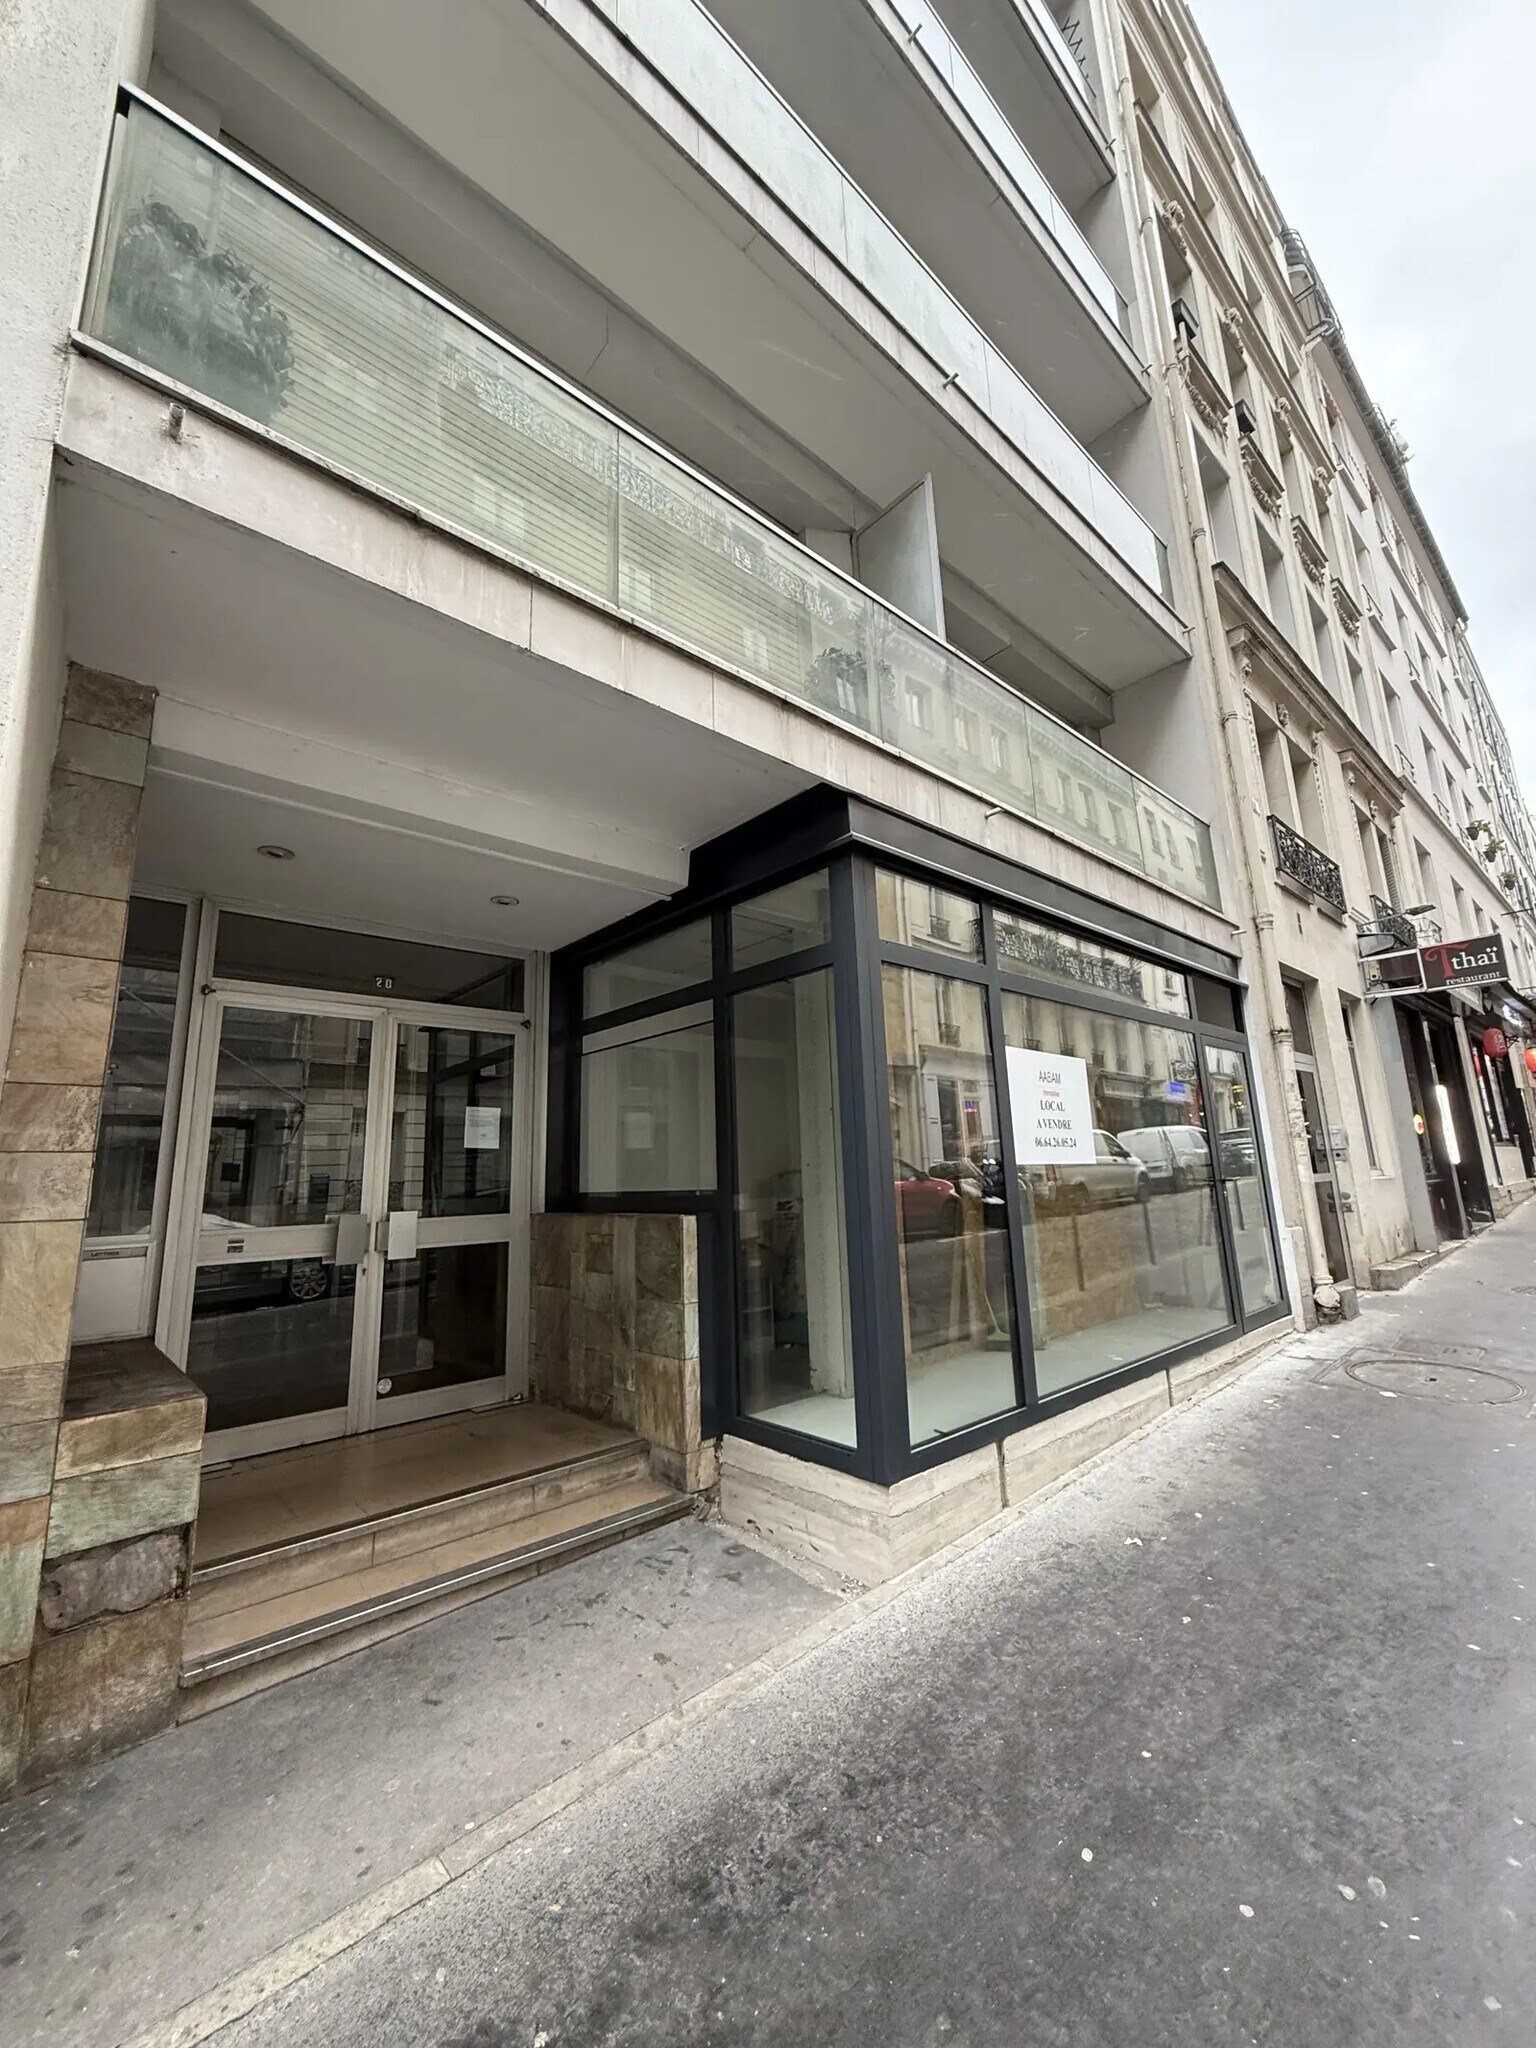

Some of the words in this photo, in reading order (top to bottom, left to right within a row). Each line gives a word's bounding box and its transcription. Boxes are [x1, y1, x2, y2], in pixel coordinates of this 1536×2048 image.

[376, 977, 392, 989] 20
[1445, 971, 1501, 986] restaurant
[1040, 1100, 1066, 1112] LOCAL
[1042, 1118, 1072, 1130] VENDRE
